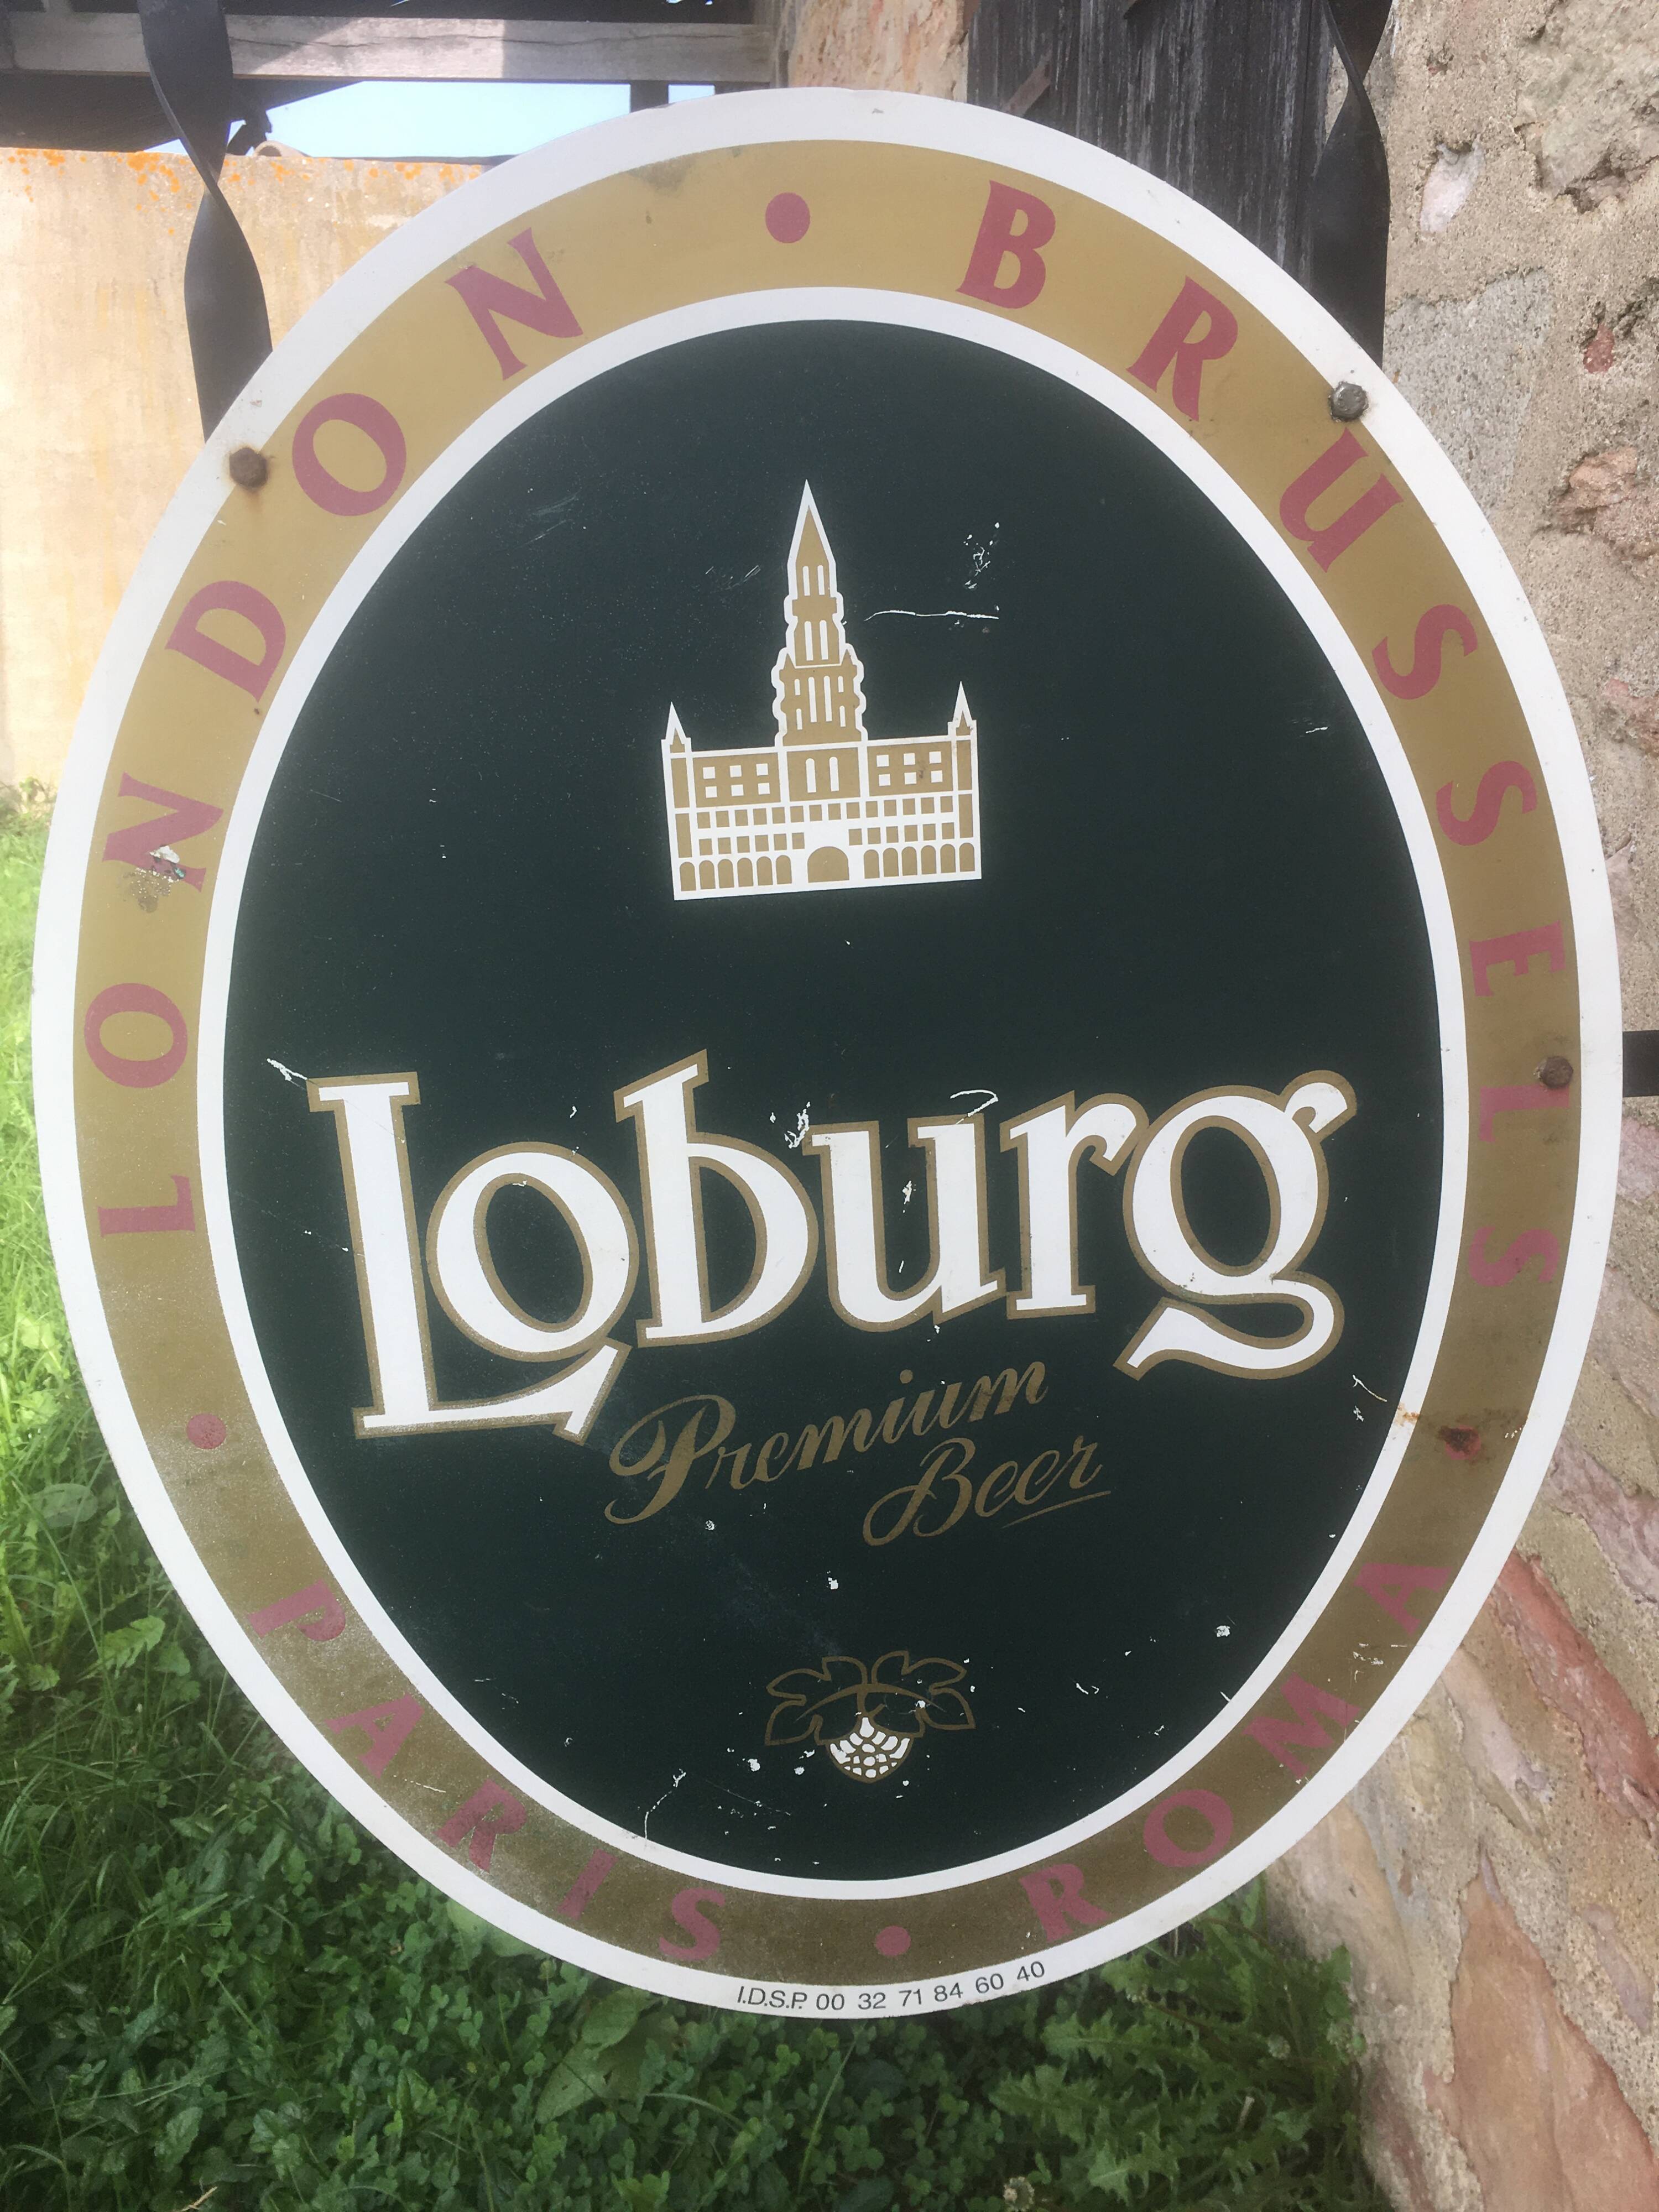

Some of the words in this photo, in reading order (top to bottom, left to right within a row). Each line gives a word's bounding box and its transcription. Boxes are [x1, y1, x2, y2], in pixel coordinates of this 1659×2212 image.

[85, 227, 585, 1237] LONDON
[955, 180, 1570, 1287] BRUSSELS
[307, 1050, 1357, 1444] Loburg
[604, 1361, 1048, 1525] Premium
[862, 1436, 1104, 1546] Beer
[248, 1579, 724, 1961] PARIS
[1019, 1561, 1455, 1942] ROMA
[816, 1993, 845, 2011] 00
[858, 1992, 886, 2010] 32
[899, 1990, 922, 2007] 71
[933, 1982, 963, 2002] 84
[975, 1973, 1004, 1994] 60
[1016, 1960, 1045, 1982] 40
